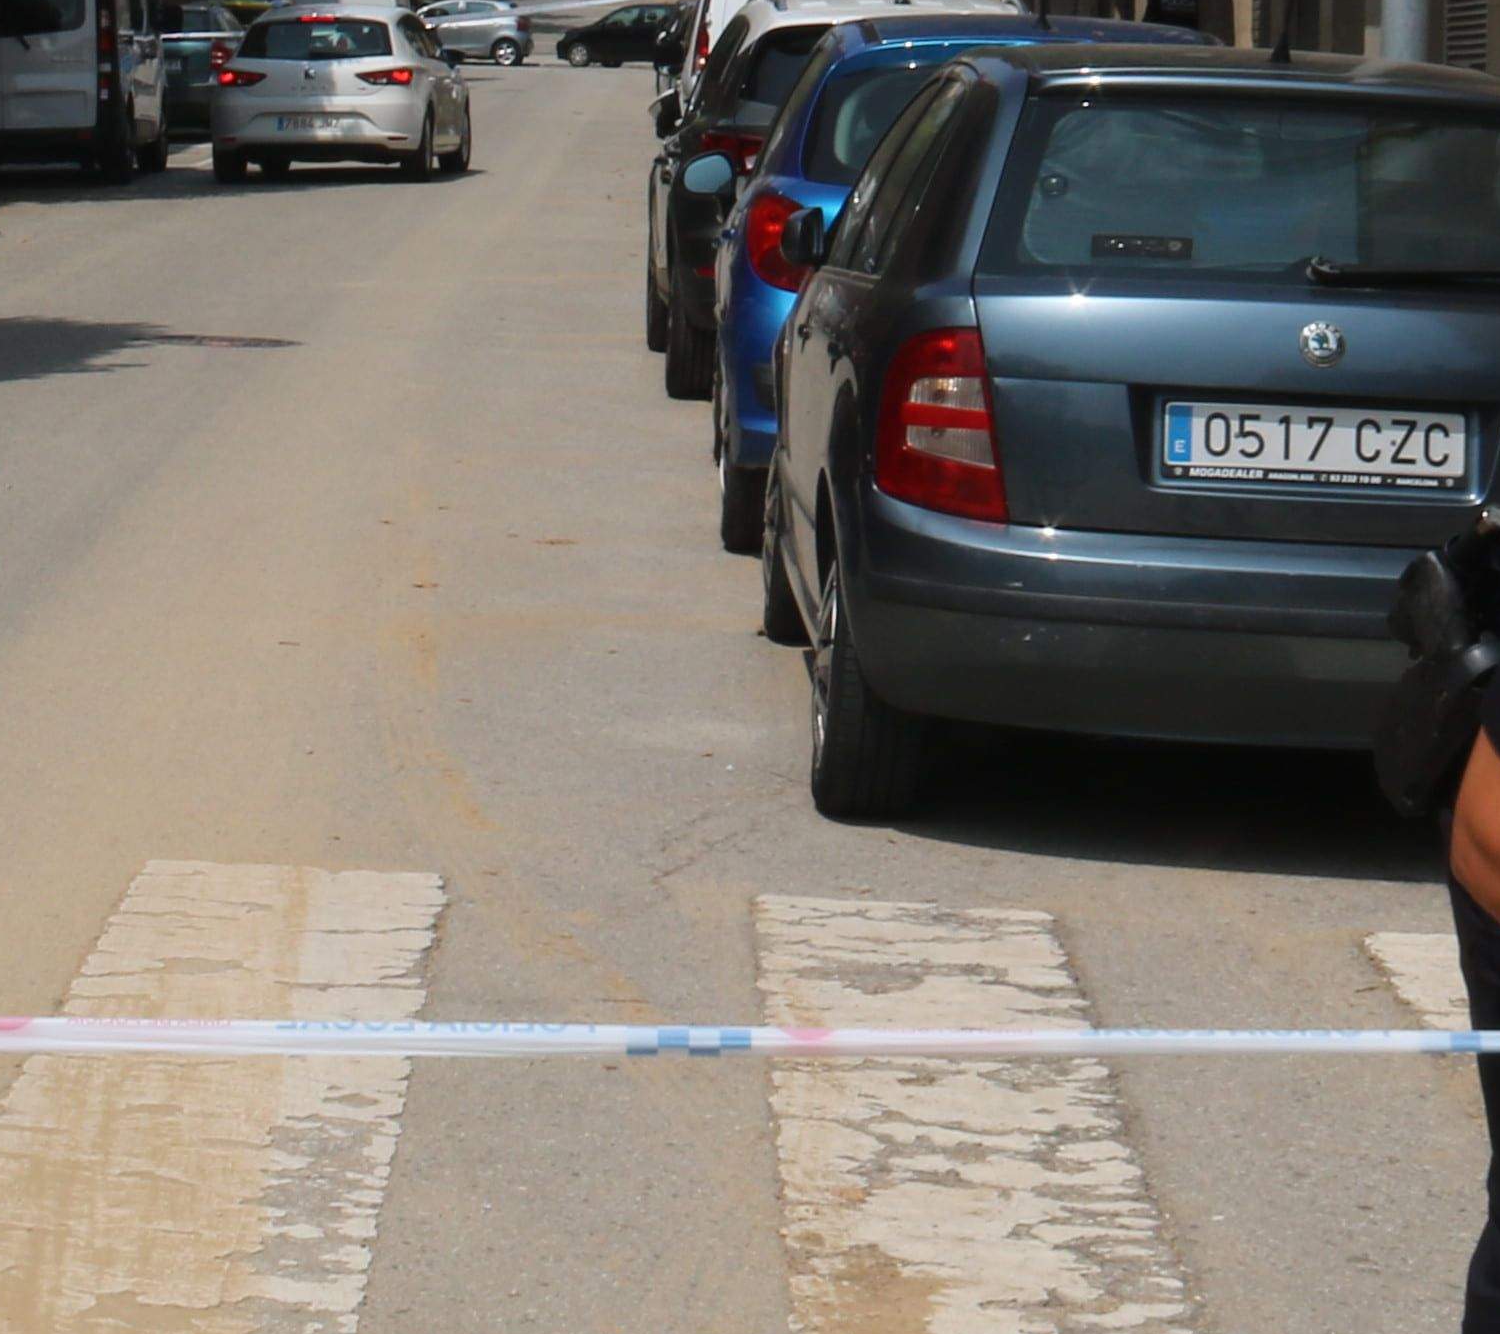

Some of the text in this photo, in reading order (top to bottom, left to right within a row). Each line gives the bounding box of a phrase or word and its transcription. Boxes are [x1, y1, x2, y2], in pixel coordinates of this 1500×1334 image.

[1174, 439, 1186, 454] E
[1204, 412, 1451, 468] 0517 CZC
[1189, 467, 1264, 480] MOGADEALER
